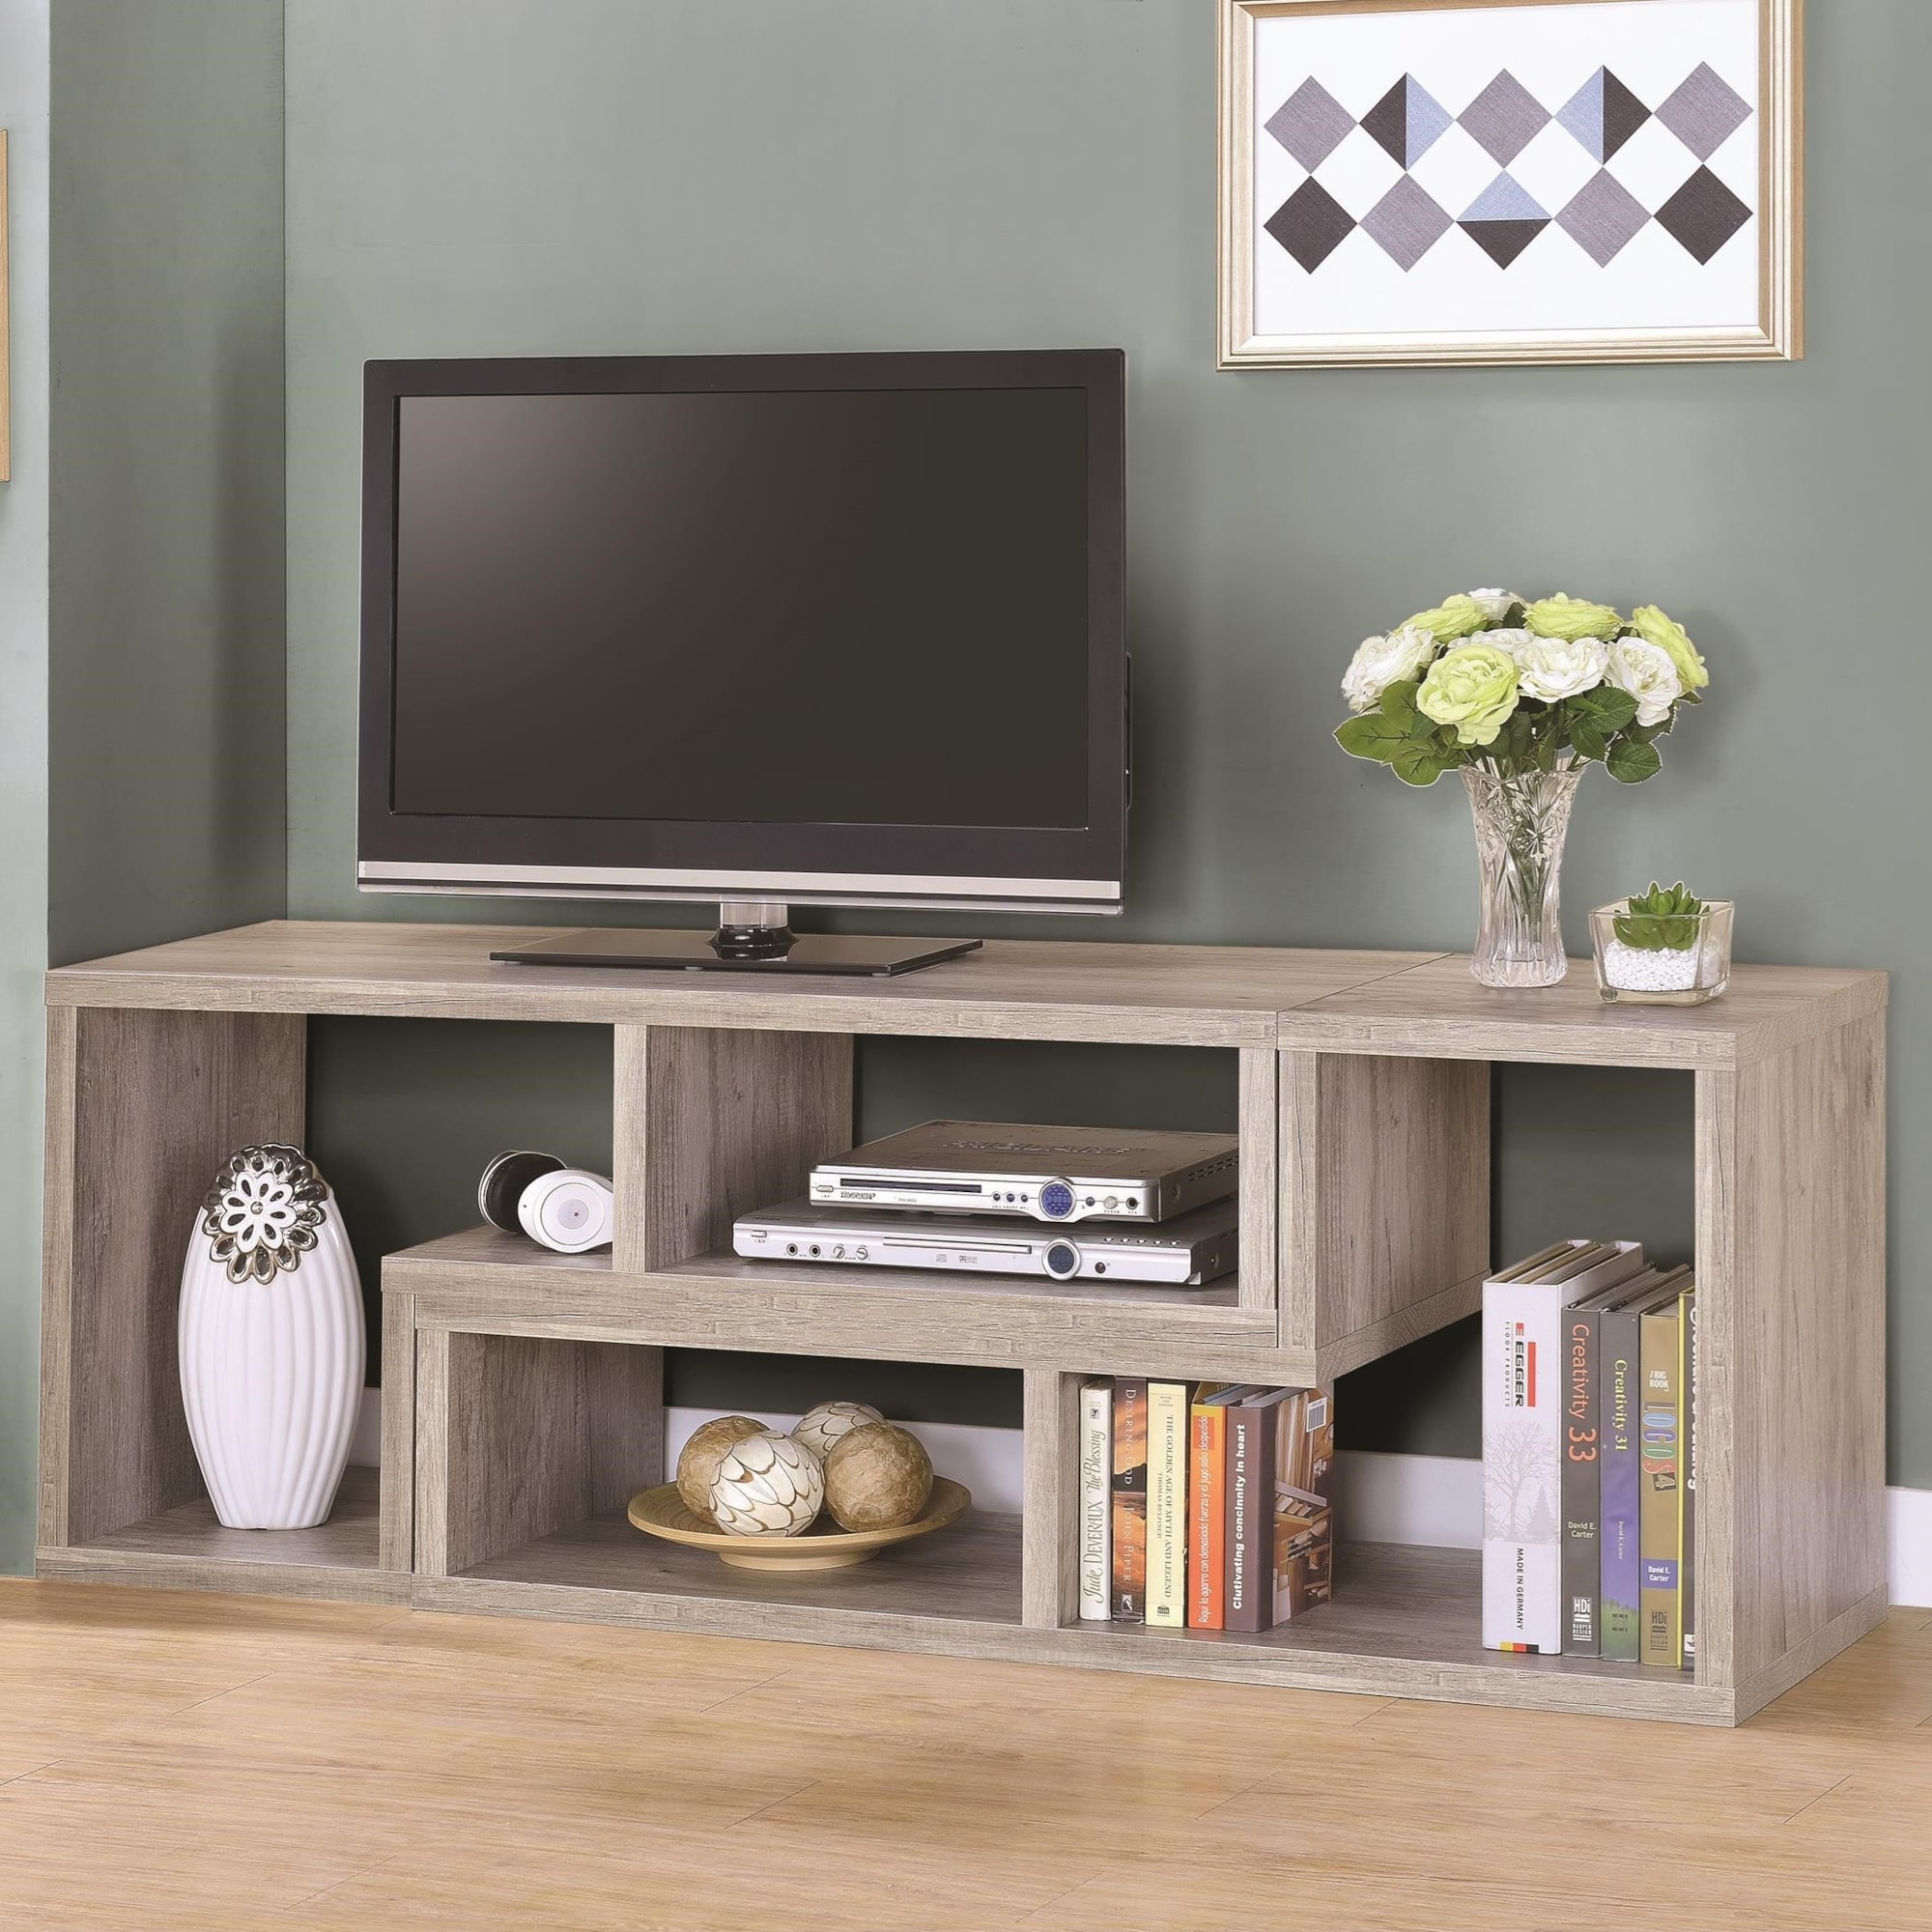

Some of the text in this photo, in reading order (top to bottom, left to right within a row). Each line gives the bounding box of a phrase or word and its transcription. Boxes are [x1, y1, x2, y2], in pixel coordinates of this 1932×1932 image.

[1515, 1341, 1524, 1407] EGGER
[1649, 1378, 1669, 1388] BOOK
[1654, 1370, 1667, 1379] BIG
[1568, 1324, 1596, 1462] Creativity 33
[1612, 1359, 1628, 1451] Creativity 31
[1125, 1389, 1136, 1451] DESIRING
[1083, 1430, 1106, 1475] Blessing
[1165, 1435, 1174, 1474] GOLDEN
[1085, 1475, 1102, 1493] The
[1165, 1495, 1173, 1509] OF
[1198, 1498, 1208, 1521] fuerza
[1233, 1424, 1246, 1609] Clutivating concinnity in heart
[1568, 1521, 1588, 1530] David
[1123, 1507, 1135, 1581] JOHN PIPER
[1571, 1529, 1594, 1538] Carter
[1164, 1539, 1173, 1559] AND
[1164, 1561, 1173, 1598] LEGEND
[1516, 1576, 1523, 1585] IN
[1648, 1565, 1664, 1574] David
[1649, 1574, 1670, 1582] Carter
[1083, 1568, 1104, 1604] Jude
